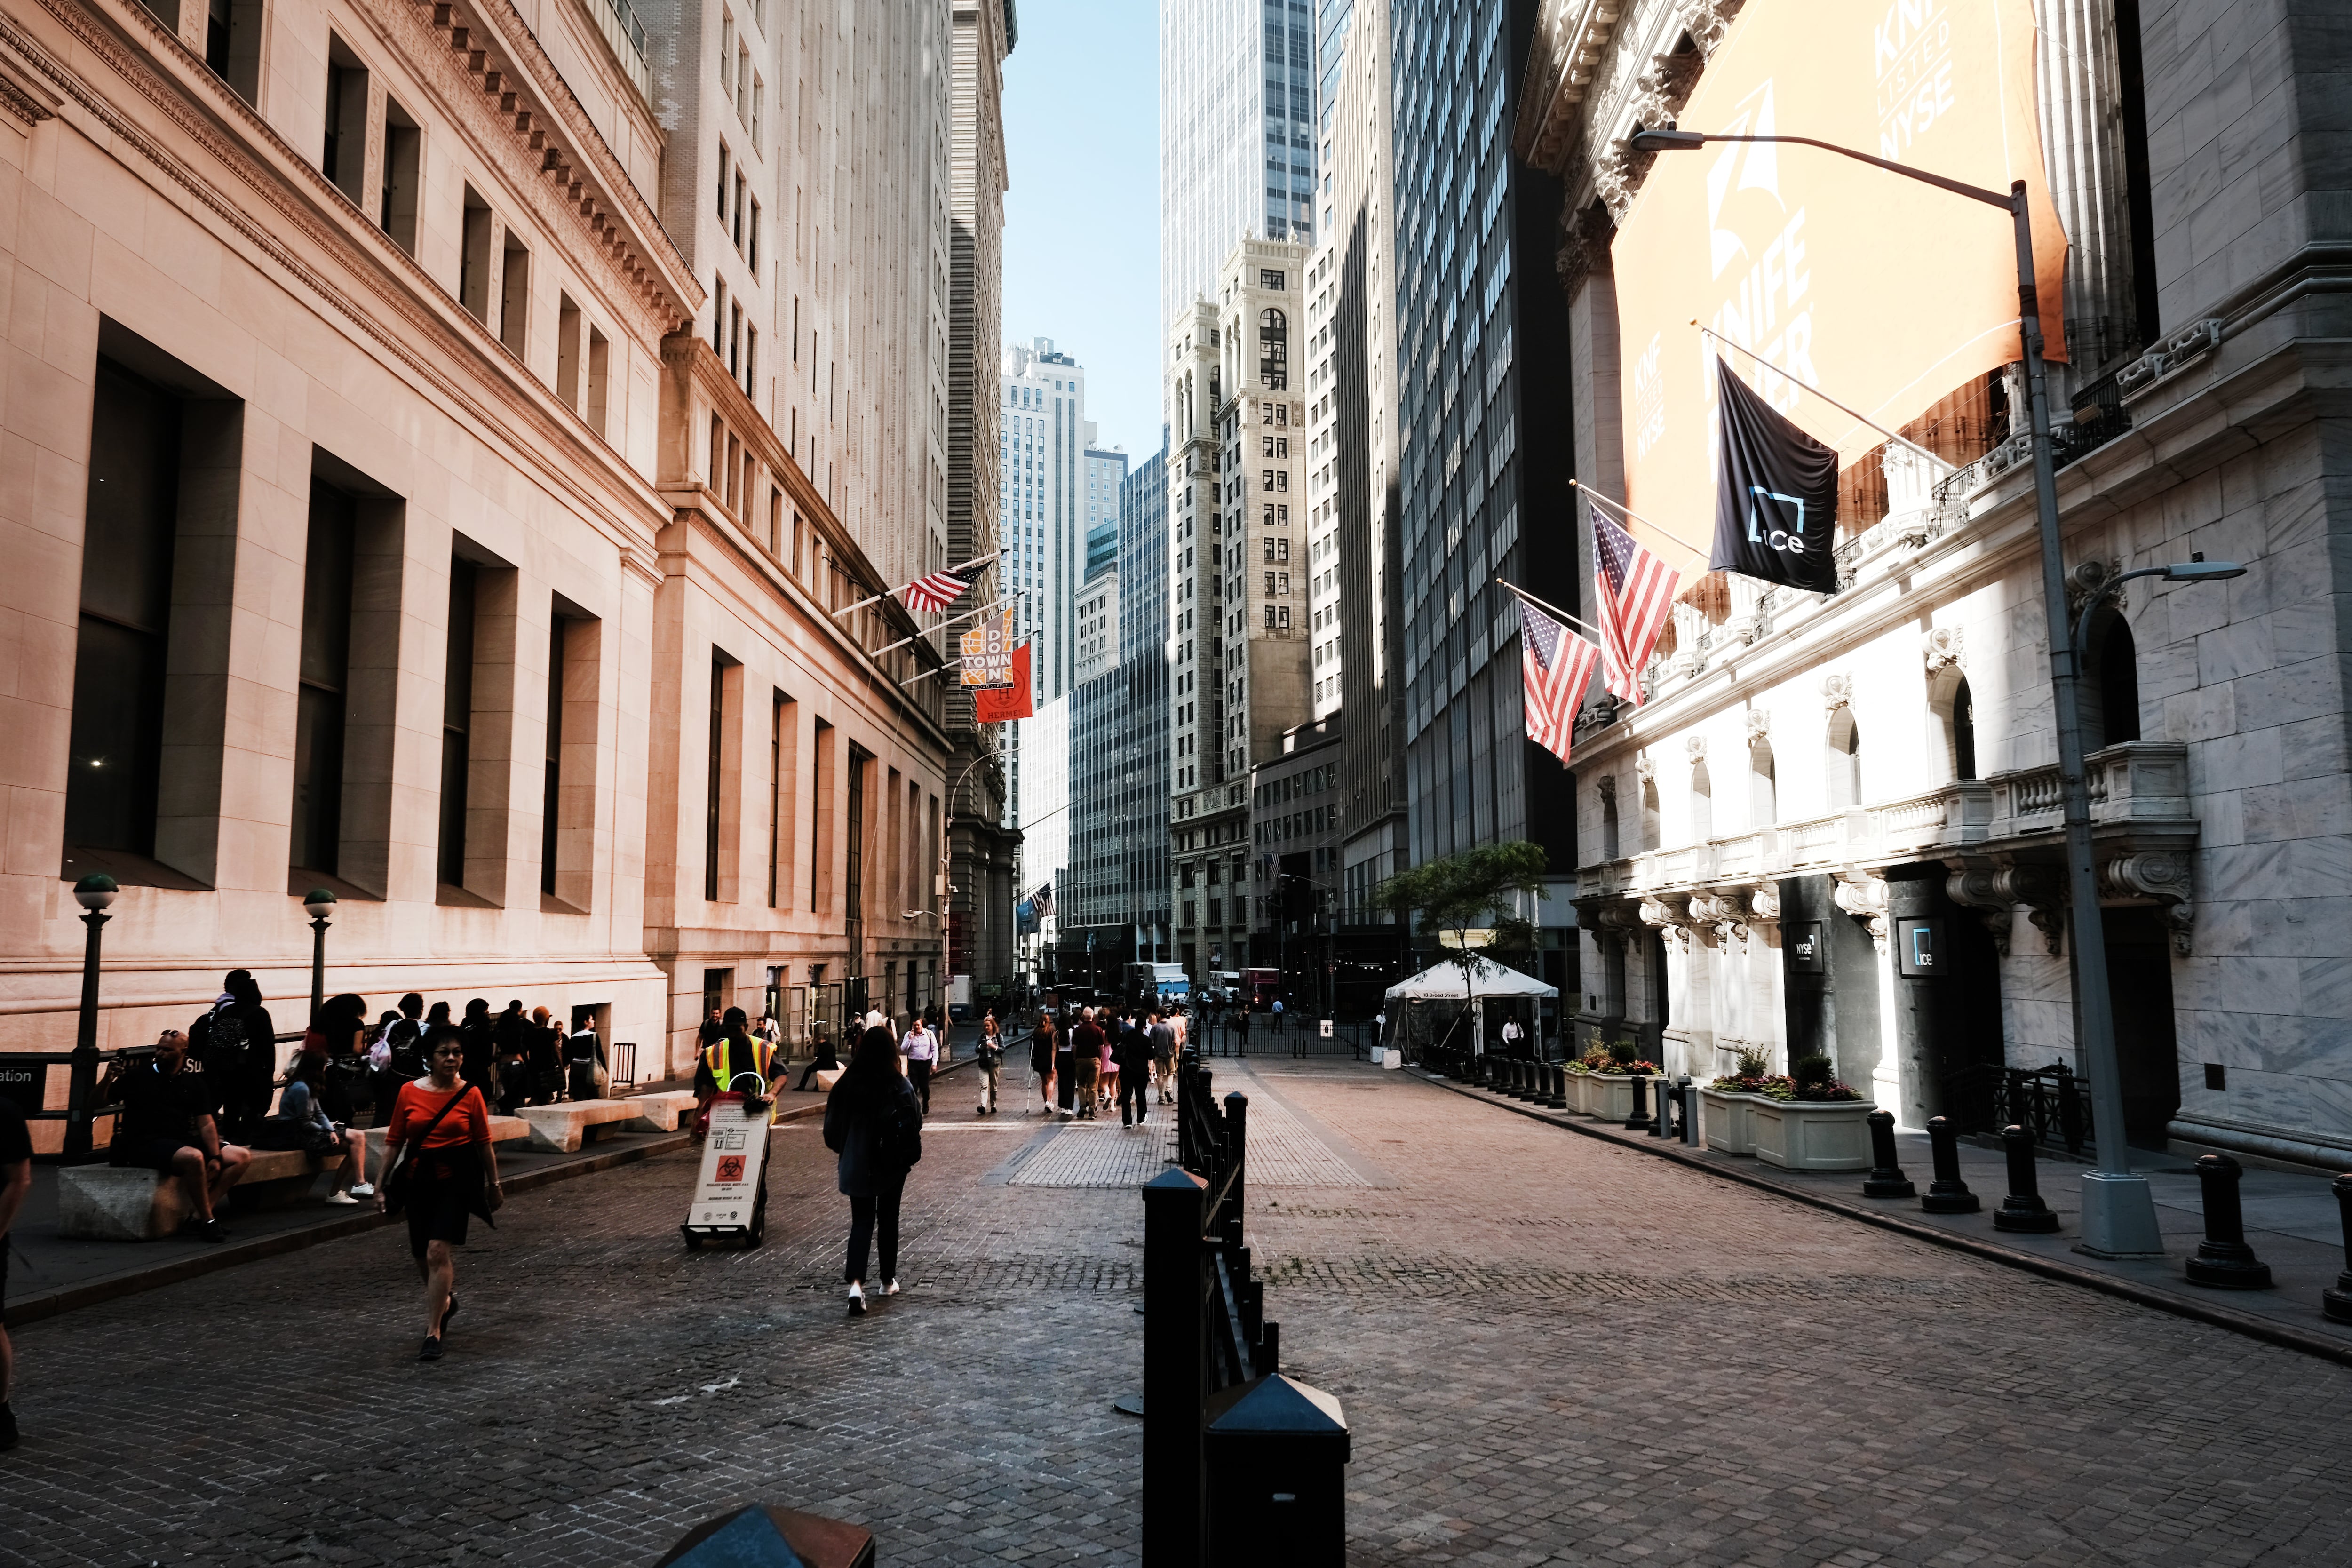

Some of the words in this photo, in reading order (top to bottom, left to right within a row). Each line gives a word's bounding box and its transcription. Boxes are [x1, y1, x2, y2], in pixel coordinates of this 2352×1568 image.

[1877, 20, 1950, 117] LISTED
[1880, 60, 1955, 174] NYSE
[1701, 205, 1810, 403] KNIFE
[1633, 330, 1661, 400] KNF
[1635, 378, 1663, 426] LISTED
[1637, 403, 1666, 463] NYSE
[962, 653, 1011, 668] TOWN
